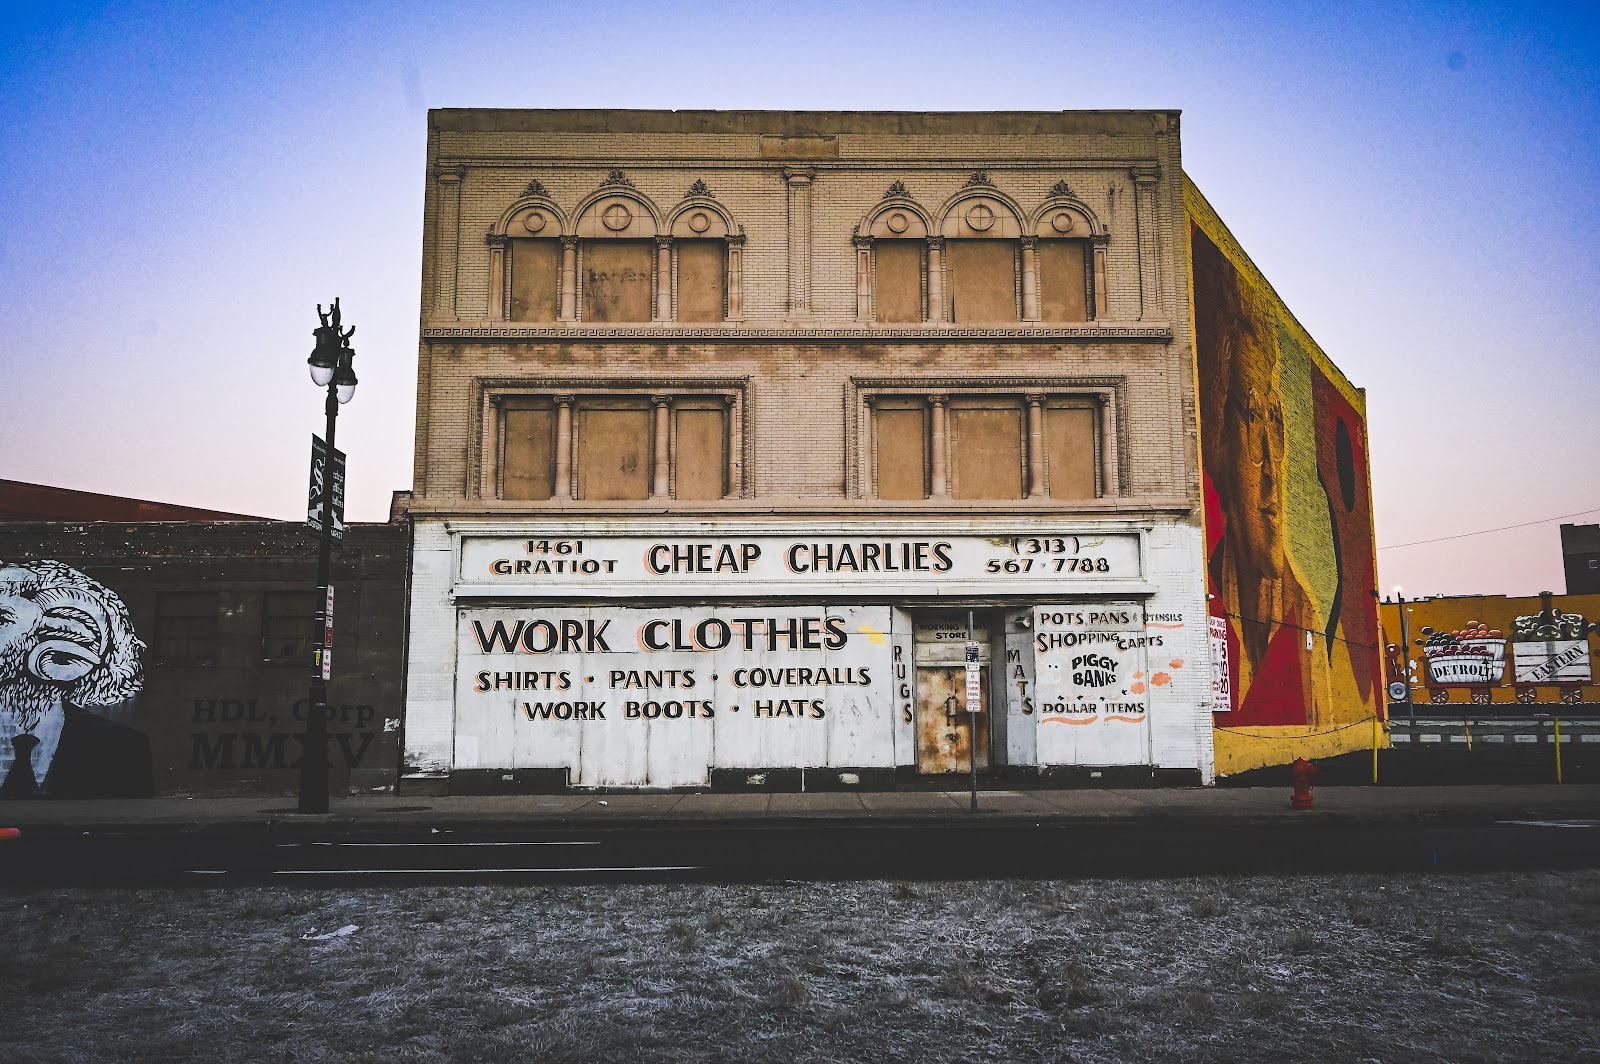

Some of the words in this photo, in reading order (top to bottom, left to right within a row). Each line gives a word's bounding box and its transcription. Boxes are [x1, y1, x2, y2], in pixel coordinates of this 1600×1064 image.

[526, 540, 583, 555] 1461
[491, 558, 618, 575] GRATIOT
[646, 542, 761, 575] CHEAP
[786, 541, 953, 575] CHARLIES
[985, 558, 1034, 574] 567
[1052, 557, 1110, 574] 7788
[1089, 611, 1130, 624] PANS
[1141, 613, 1183, 622] UTENSILS
[472, 619, 612, 653] WORK
[636, 616, 847, 652] CLOTHES
[936, 632, 967, 640] STORE
[1036, 632, 1120, 653] SHOPPING
[1116, 635, 1164, 651] CARTS
[1072, 653, 1119, 672] PIGGY
[1531, 645, 1585, 681] EASTERN
[475, 670, 571, 692] SHIRTS
[608, 669, 696, 689] PANTS
[732, 667, 872, 688] COVERALLS
[893, 645, 913, 724] RUGS
[1007, 649, 1034, 716] MATS
[1073, 669, 1117, 688] BANKS
[523, 700, 606, 721] WORK
[625, 700, 715, 720] BOOTS
[754, 698, 825, 720] HATS
[1042, 703, 1097, 714] DOLLAR
[1104, 702, 1146, 714] ITEMS
